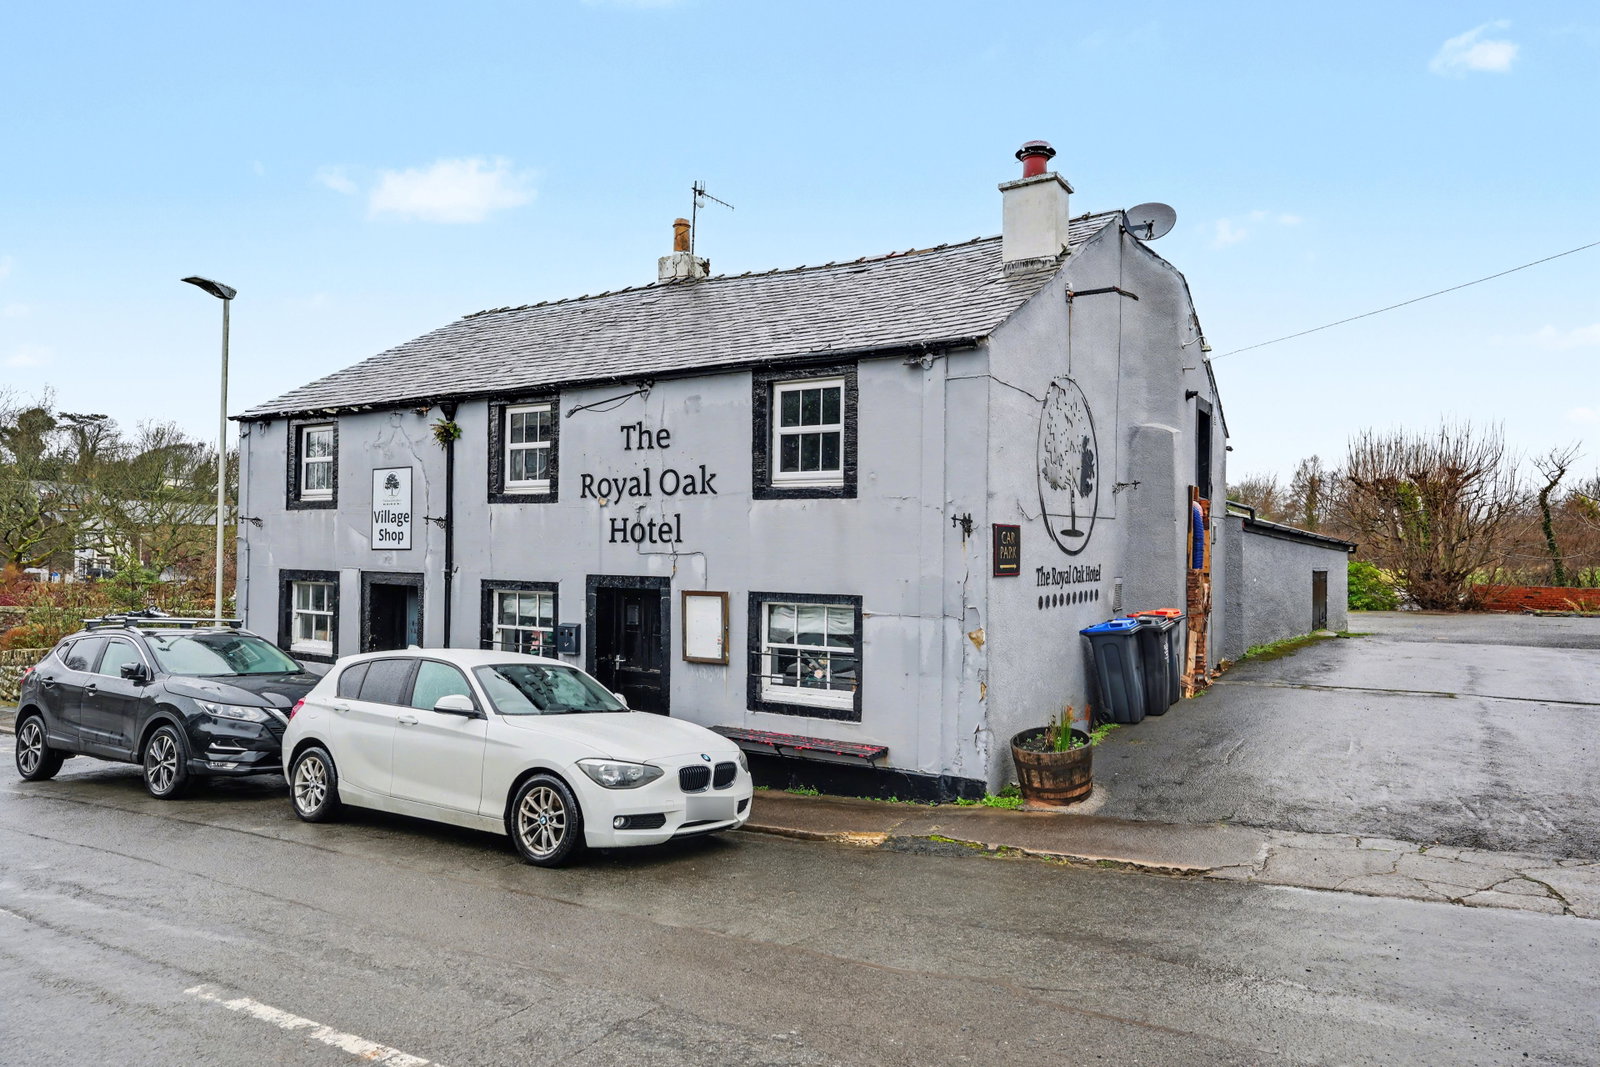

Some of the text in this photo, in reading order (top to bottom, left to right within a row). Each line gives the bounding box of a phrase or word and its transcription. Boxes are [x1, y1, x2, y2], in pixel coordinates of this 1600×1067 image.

[620, 421, 671, 451] The
[580, 464, 718, 505] Royal Oak
[373, 509, 410, 527] Village
[608, 513, 683, 544] Hotel
[378, 528, 404, 544] Shop
[1001, 531, 1016, 544] CAR
[1000, 546, 1017, 559] PARK
[1036, 563, 1102, 590] The Royal Oak Hotel
